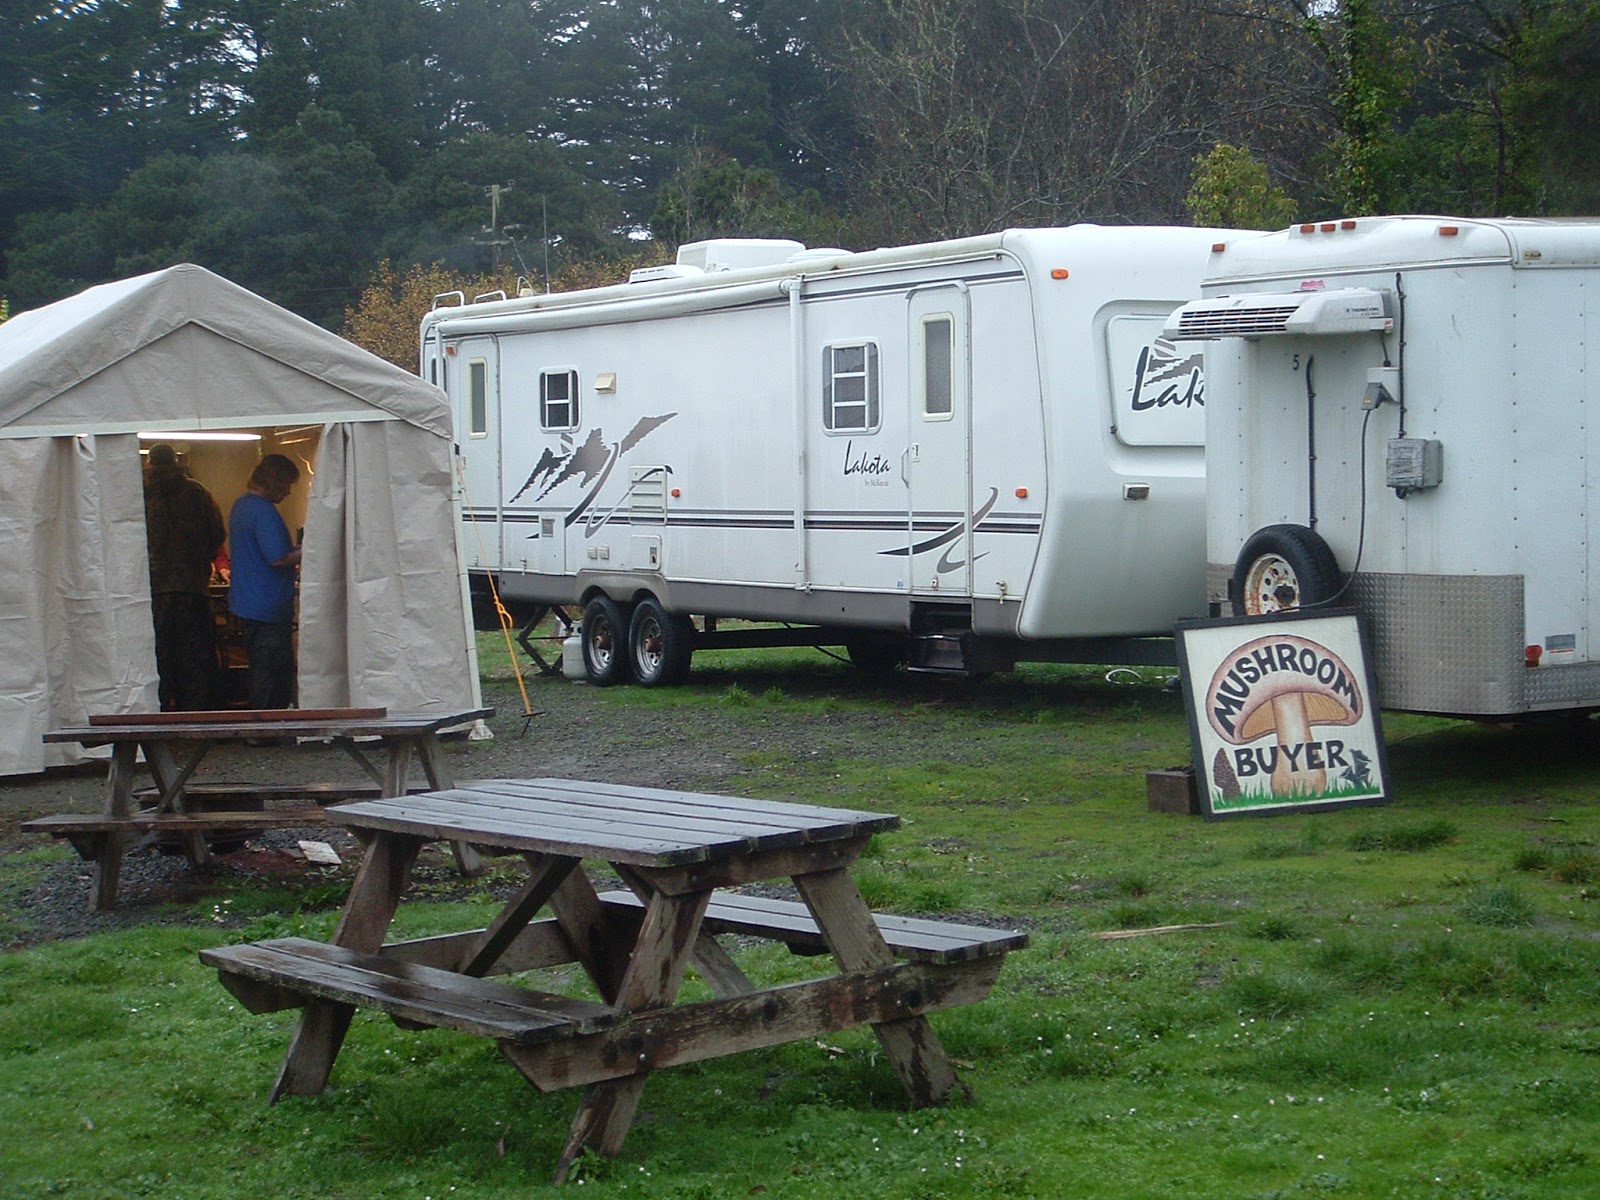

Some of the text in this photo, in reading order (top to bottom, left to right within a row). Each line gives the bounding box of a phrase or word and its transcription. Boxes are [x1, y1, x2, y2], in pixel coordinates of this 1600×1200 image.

[1293, 354, 1299, 371] 5
[843, 440, 890, 475] Lakota
[1214, 644, 1358, 739] MUSHROOM
[1234, 740, 1348, 777] BUYER
